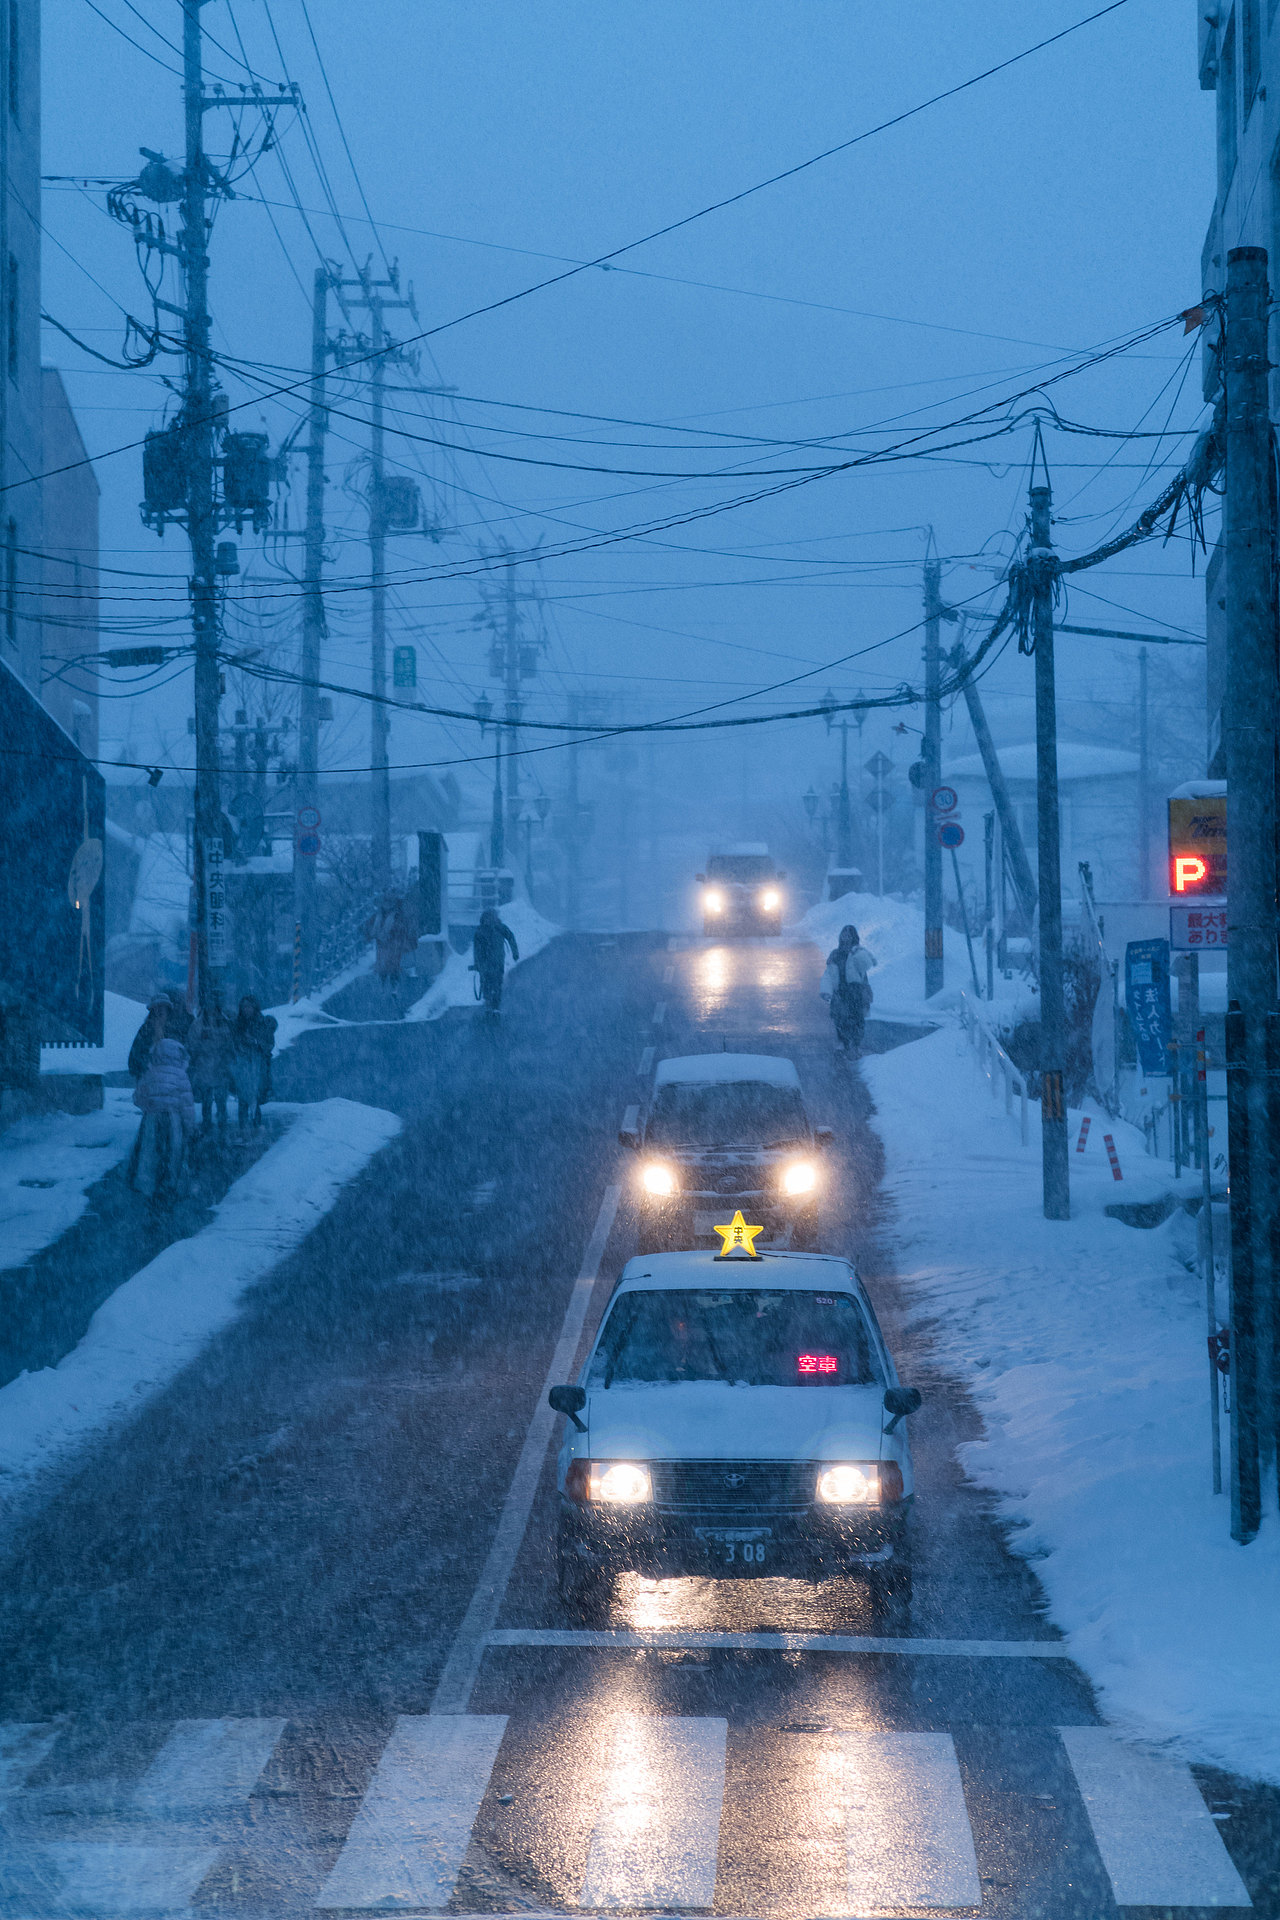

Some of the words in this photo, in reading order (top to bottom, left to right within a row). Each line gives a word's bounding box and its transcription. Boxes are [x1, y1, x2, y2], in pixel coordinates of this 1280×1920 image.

[937, 793, 953, 805] 30
[1175, 857, 1206, 891] P
[733, 1226, 744, 1244] 中央
[798, 1354, 838, 1374] 空車
